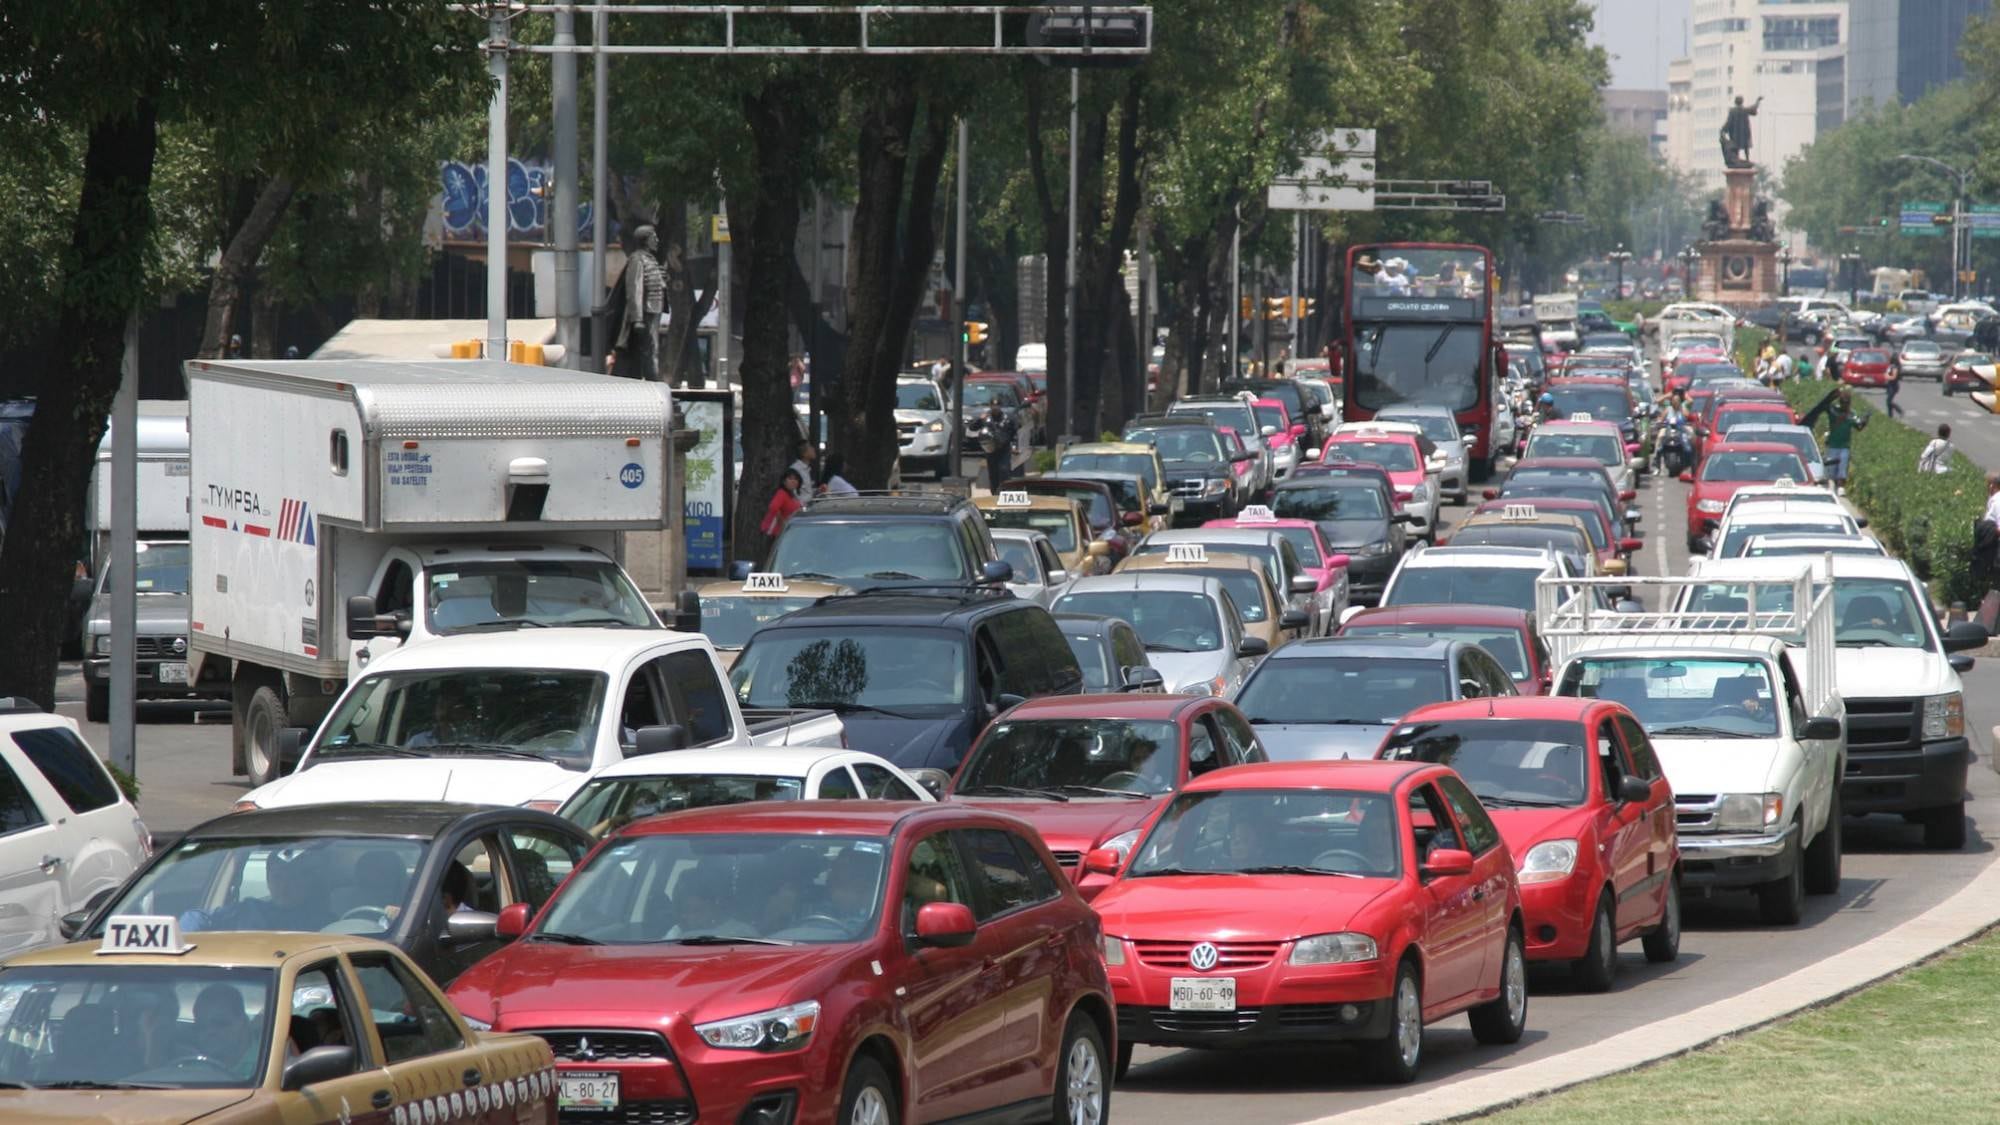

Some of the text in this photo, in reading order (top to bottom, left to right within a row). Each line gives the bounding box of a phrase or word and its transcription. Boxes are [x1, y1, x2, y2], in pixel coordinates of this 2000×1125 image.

[621, 469, 643, 483] 405
[208, 484, 260, 515] TYMPSA
[1002, 493, 1025, 503] TAXI
[1247, 507, 1266, 517] TAXI
[751, 576, 779, 588] TAXI
[110, 923, 169, 948] TAXI
[1173, 986, 1233, 1001] MBD-60-49
